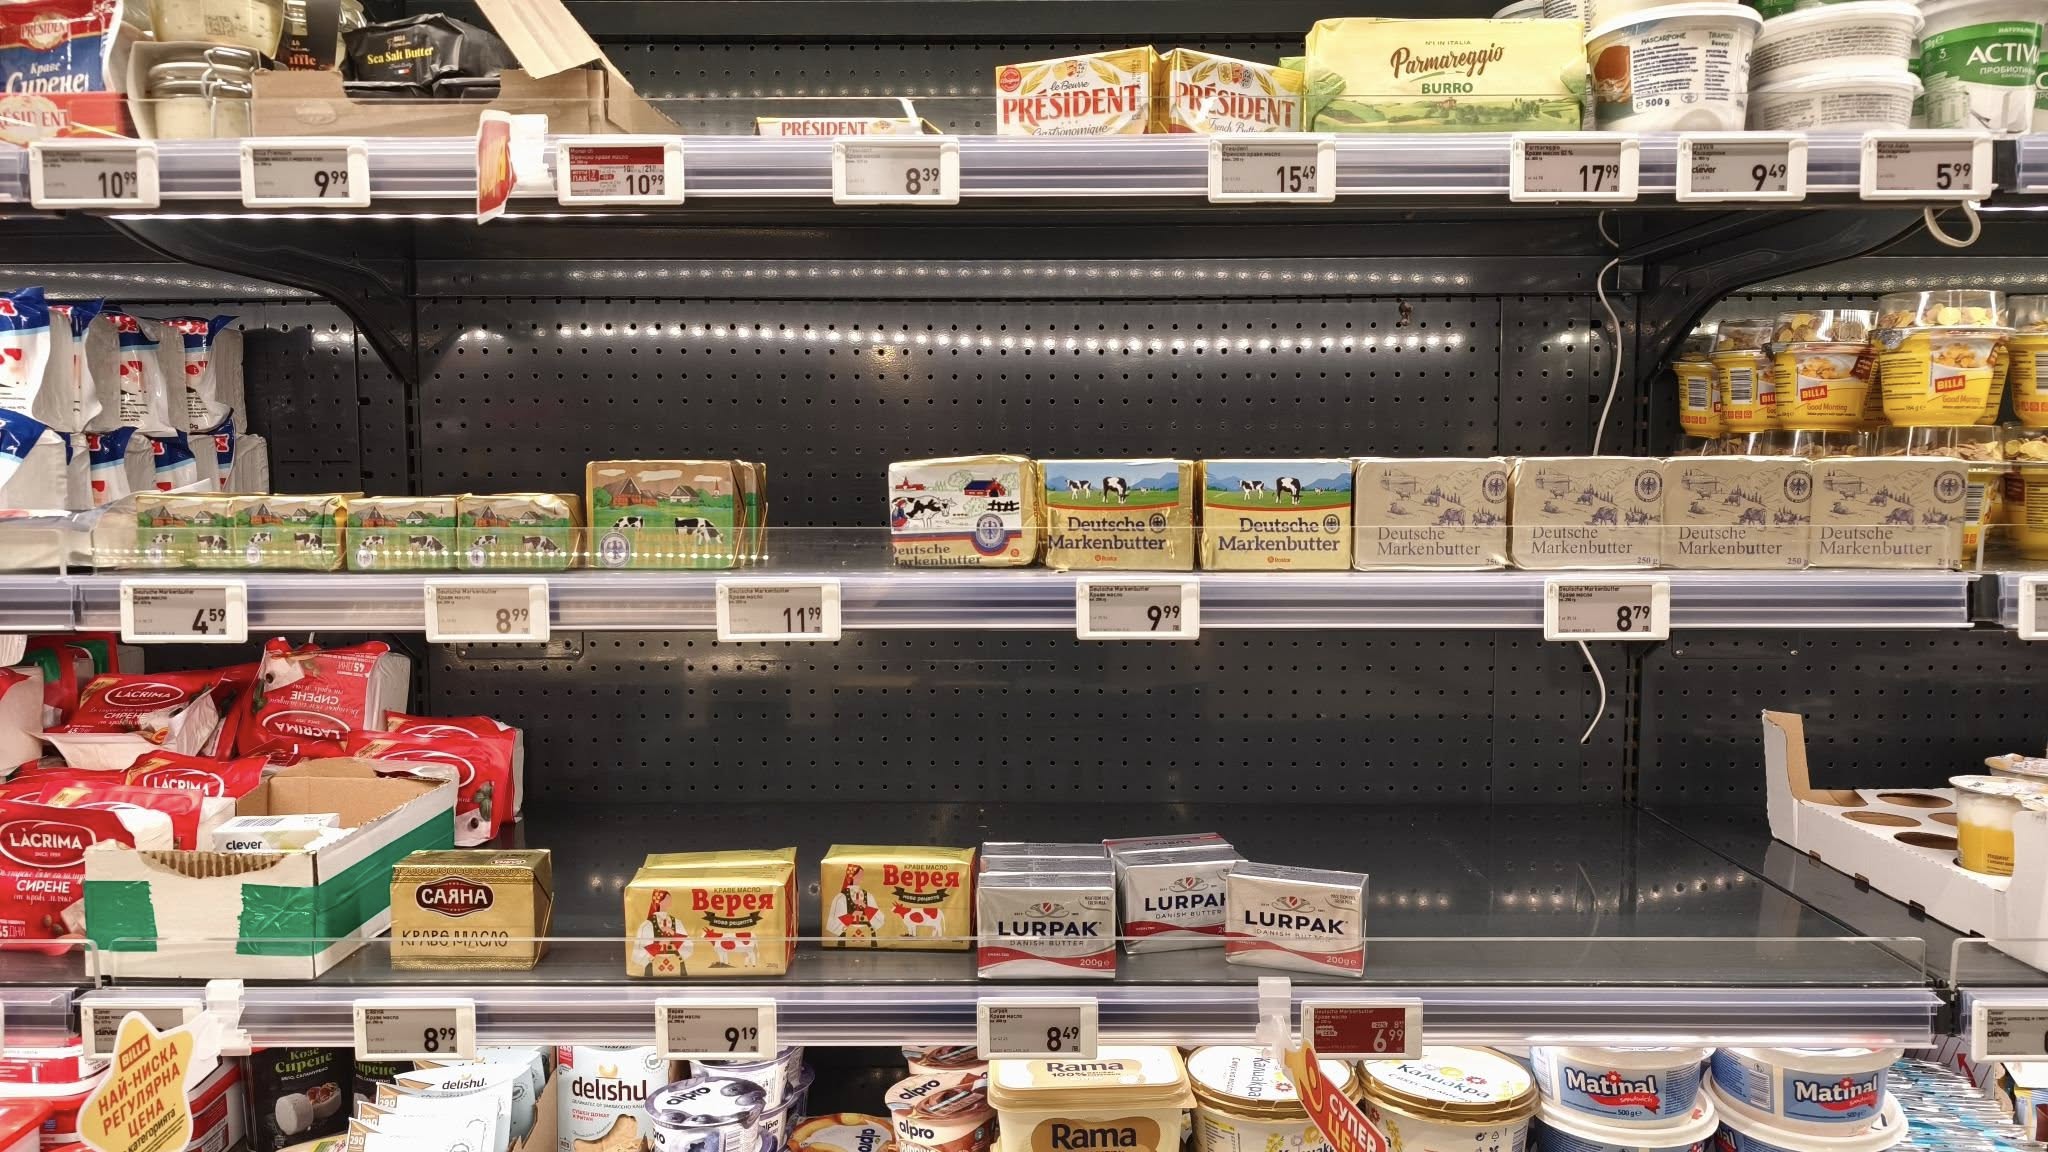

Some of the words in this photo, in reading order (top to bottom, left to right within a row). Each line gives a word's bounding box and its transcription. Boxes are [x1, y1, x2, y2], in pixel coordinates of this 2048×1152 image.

[1641, 32, 1686, 45] MASCARPONE
[367, 54, 384, 65] Sea
[385, 51, 403, 63] Salt
[405, 46, 434, 60] Butter
[1390, 43, 1504, 79] Parmareggio
[30, 62, 61, 76] Краве
[1050, 79, 1060, 91] le
[1061, 79, 1090, 91] Beurre
[1421, 82, 1474, 94] BURRO
[1003, 84, 1141, 127] PRÉSIDENT
[1175, 80, 1297, 128] PRÉSIDENT
[1645, 98, 1663, 108] 500
[1664, 99, 1670, 108] g
[781, 120, 868, 136] PRÉSIDENT
[1031, 123, 1109, 136] Gastronomique
[1937, 379, 1964, 391] BILLA
[1761, 394, 1775, 404] BIL
[1803, 389, 1827, 399] BILLA
[1942, 395, 1960, 403] Good
[1824, 403, 1848, 411] Morning
[1068, 516, 1145, 532] Deutsche
[1239, 517, 1319, 533] Deutsche
[1378, 526, 1446, 541] Deutsche
[1532, 526, 1598, 539] Deutsche
[1678, 526, 1746, 540] Deutsche
[1820, 526, 1894, 540] Deutsche
[1048, 535, 1166, 551] Markenbutter
[1218, 536, 1341, 552] Markenbutter
[1377, 541, 1481, 556] Markenbutter
[1531, 541, 1633, 555] Markenbutter
[1678, 541, 1783, 556] Markenbutter
[1819, 541, 1933, 556] Markenbutter
[1637, 556, 1652, 565] 250
[1653, 558, 1659, 567] g
[1787, 557, 1802, 566] 250
[290, 690, 339, 705] СИРЕНЕ
[225, 839, 263, 850] clever
[883, 864, 960, 893] Верея
[16, 879, 71, 894] СИРЕНЕ
[421, 888, 488, 905] САЯНА
[691, 888, 774, 917] Верея
[1155, 911, 1187, 920] DANISH
[1190, 909, 1222, 918] BUTTER
[714, 918, 728, 926] нова
[729, 918, 753, 927] рецепта
[998, 921, 1098, 937] LURPAK
[1245, 910, 1345, 935] LURPAK
[9, 925, 26, 937] ДНИ
[1256, 928, 1291, 937] DANISH
[1080, 958, 1103, 967] 200g
[1326, 955, 1351, 966] 200g
[290, 1047, 320, 1060] Козе
[275, 1052, 333, 1073] Сирене
[1046, 1062, 1124, 1072] Rama
[98, 1041, 178, 1117] НАЙ-НИСКА
[441, 1077, 485, 1091] delishu
[1397, 1062, 1491, 1099] Калиакра
[1566, 1067, 1658, 1096] Matinal
[571, 1076, 647, 1102] delishu
[666, 1086, 711, 1106] alpro
[899, 1079, 940, 1100] alpro
[1795, 1075, 1879, 1103] Matinal
[102, 1062, 181, 1137] РЕГУЛЯРНА
[1619, 1095, 1653, 1103] sandwich
[127, 1097, 165, 1139] ЦЕНА
[1617, 1109, 1630, 1117] 500
[1630, 1110, 1635, 1118] g
[899, 1119, 935, 1140] alpro
[1329, 1093, 1377, 1152] СУПЕР
[349, 1135, 364, 1145] 290
[1051, 1123, 1137, 1150] Rama
